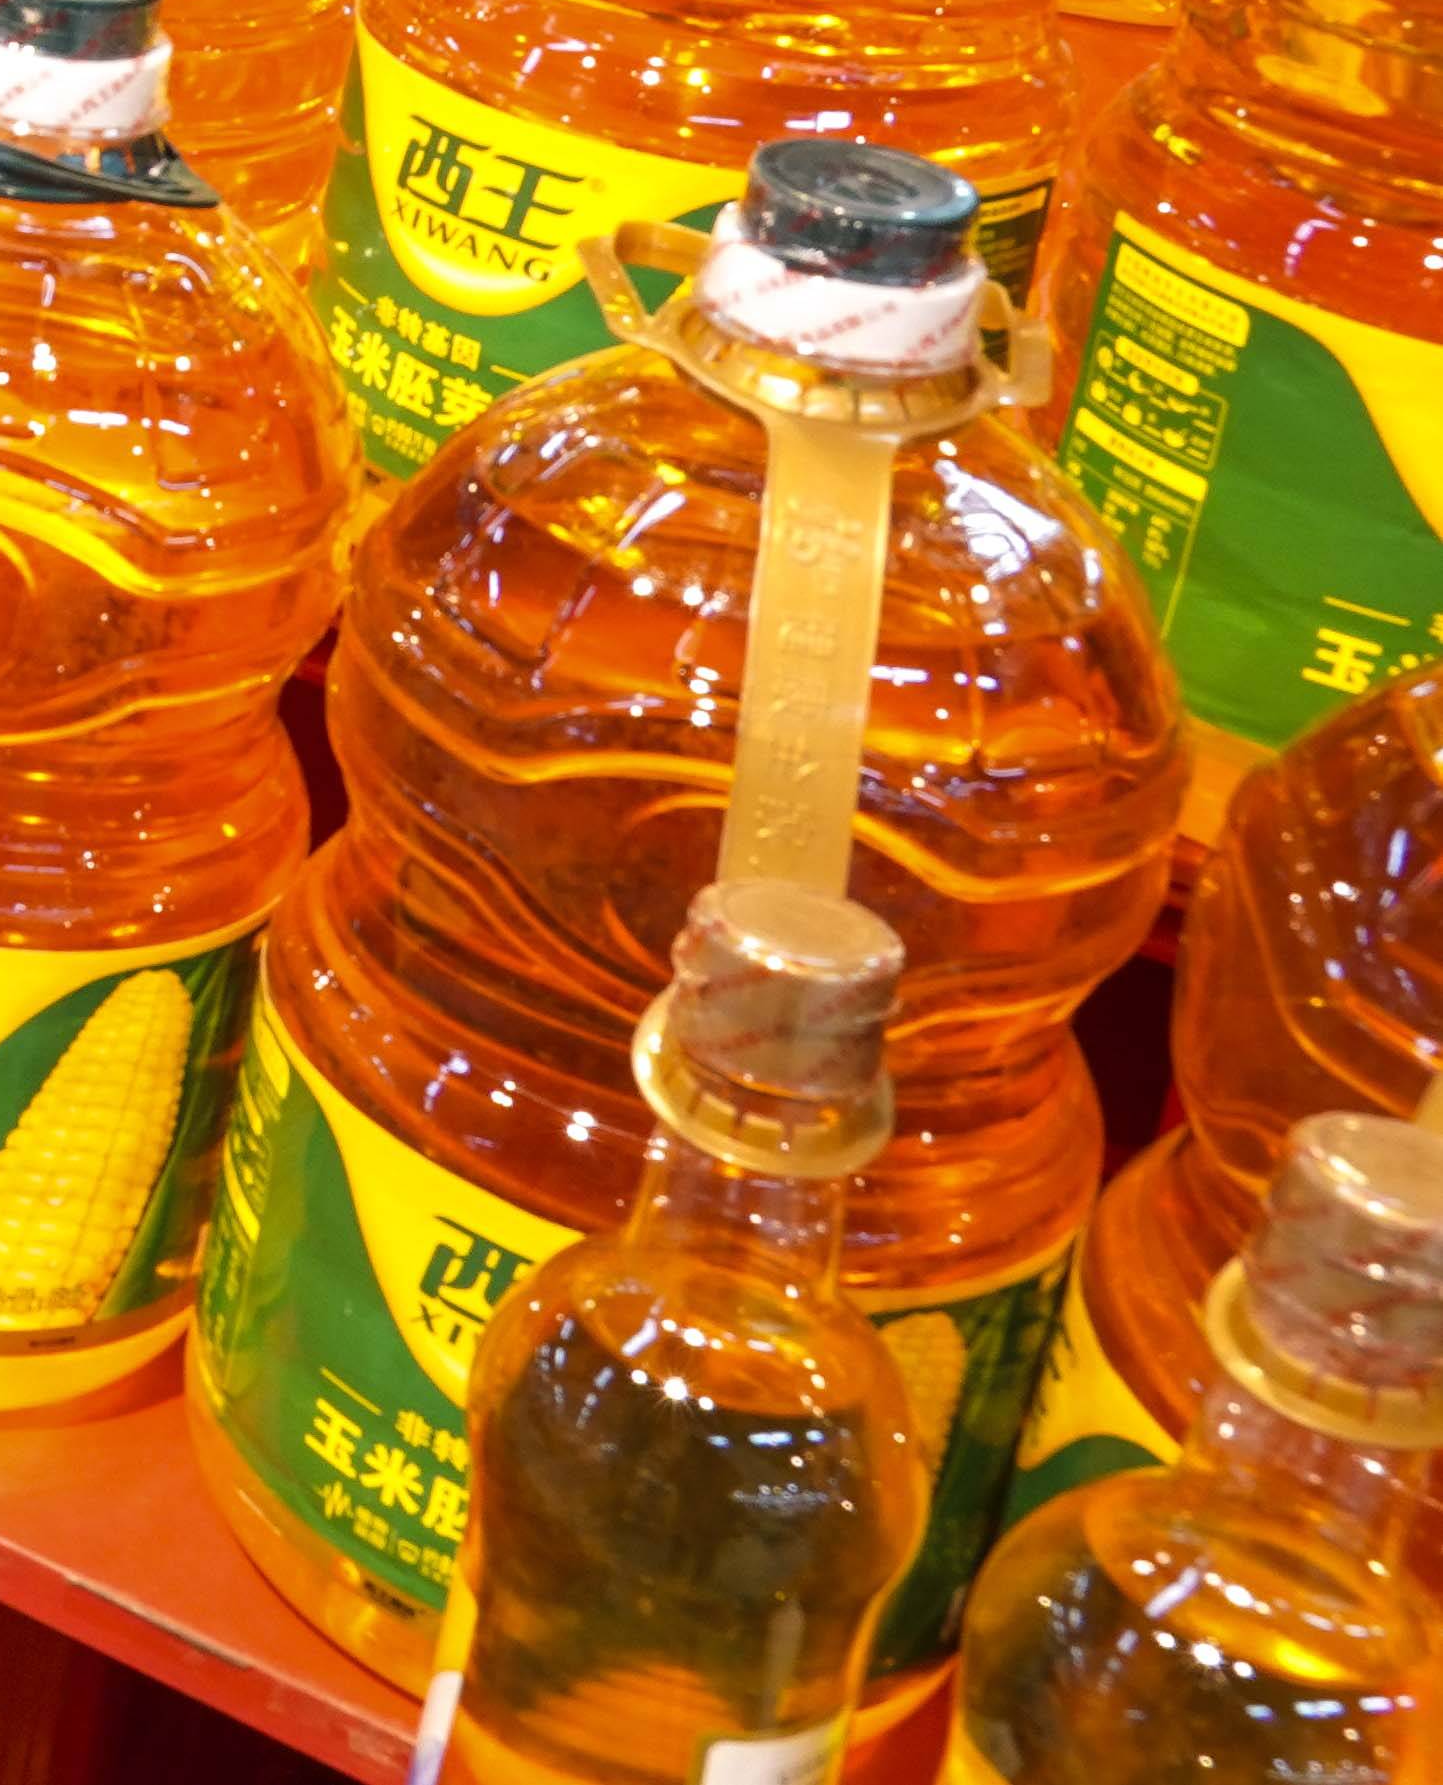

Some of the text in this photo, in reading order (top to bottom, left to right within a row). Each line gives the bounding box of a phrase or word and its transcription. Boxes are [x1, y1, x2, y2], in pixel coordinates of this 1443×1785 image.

[397, 114, 585, 251] 西王
[389, 195, 556, 284] XIWANG
[374, 296, 482, 371] 非转基因
